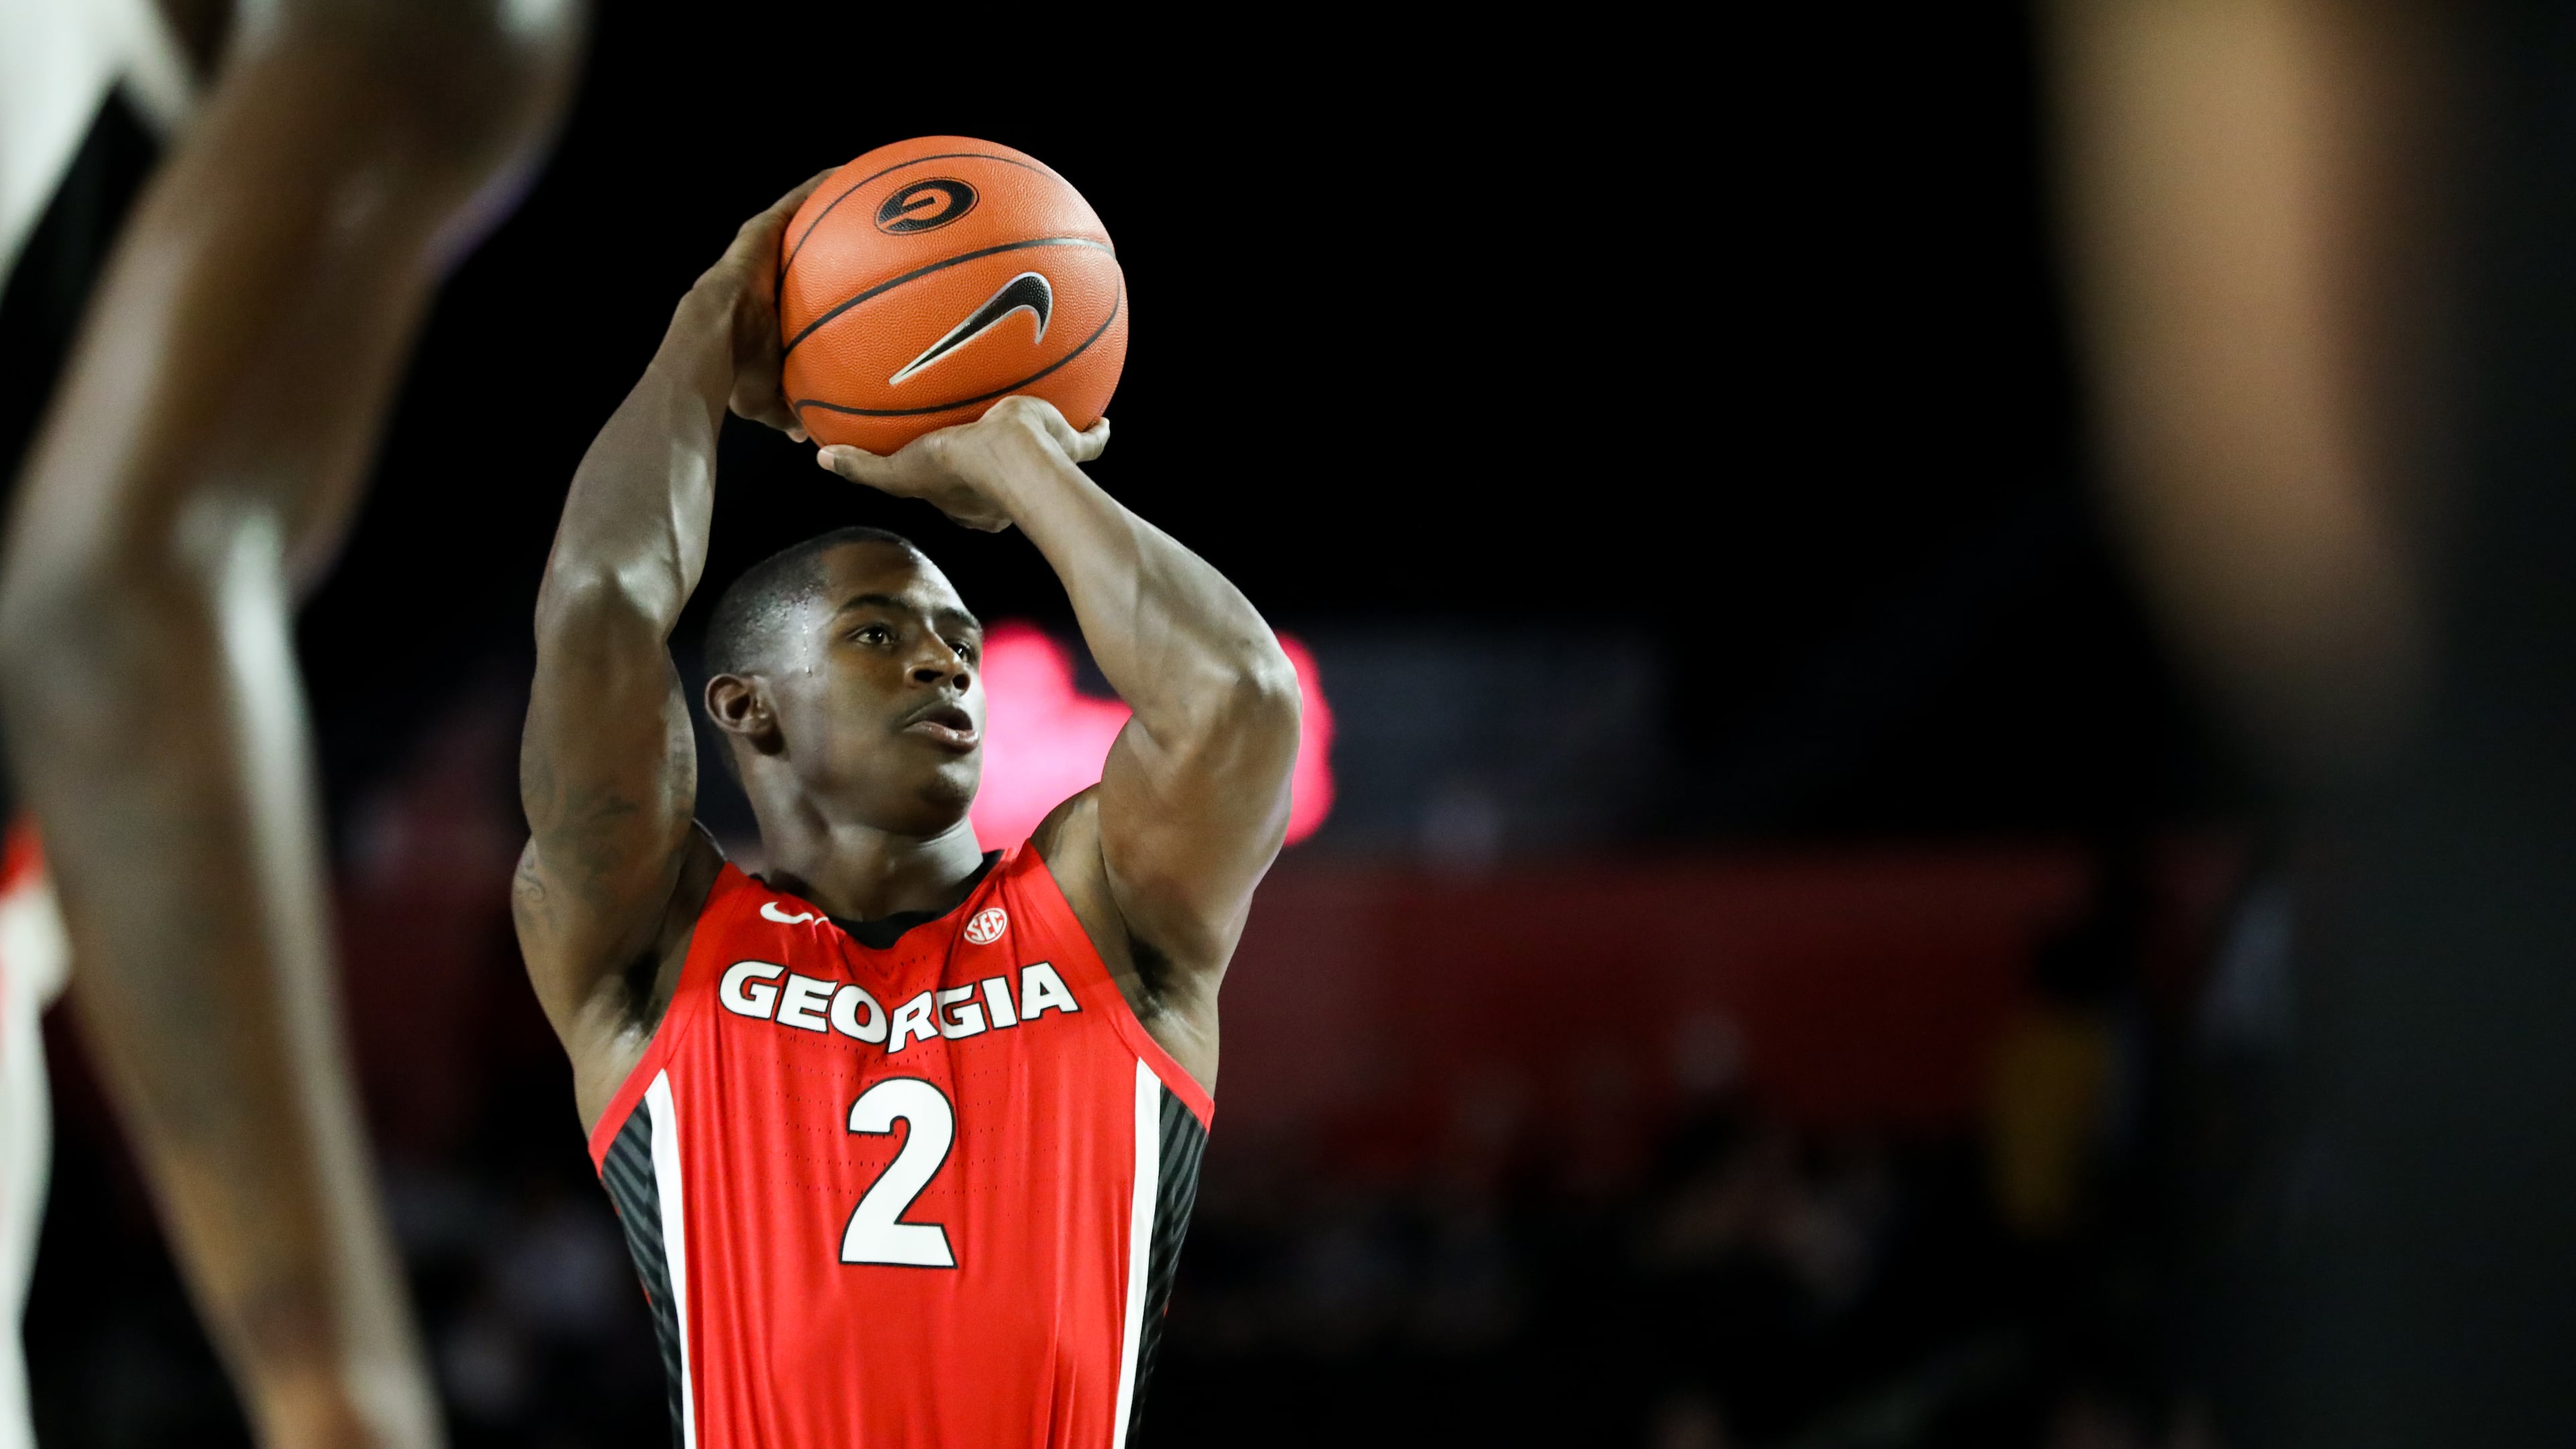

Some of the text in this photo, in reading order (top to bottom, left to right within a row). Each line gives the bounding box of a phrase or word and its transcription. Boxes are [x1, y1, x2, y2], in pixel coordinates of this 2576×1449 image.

[877, 179, 976, 232] G
[967, 910, 1004, 941] SEC
[719, 960, 1081, 1054] GEORGIA
[840, 1077, 957, 1268] 2
